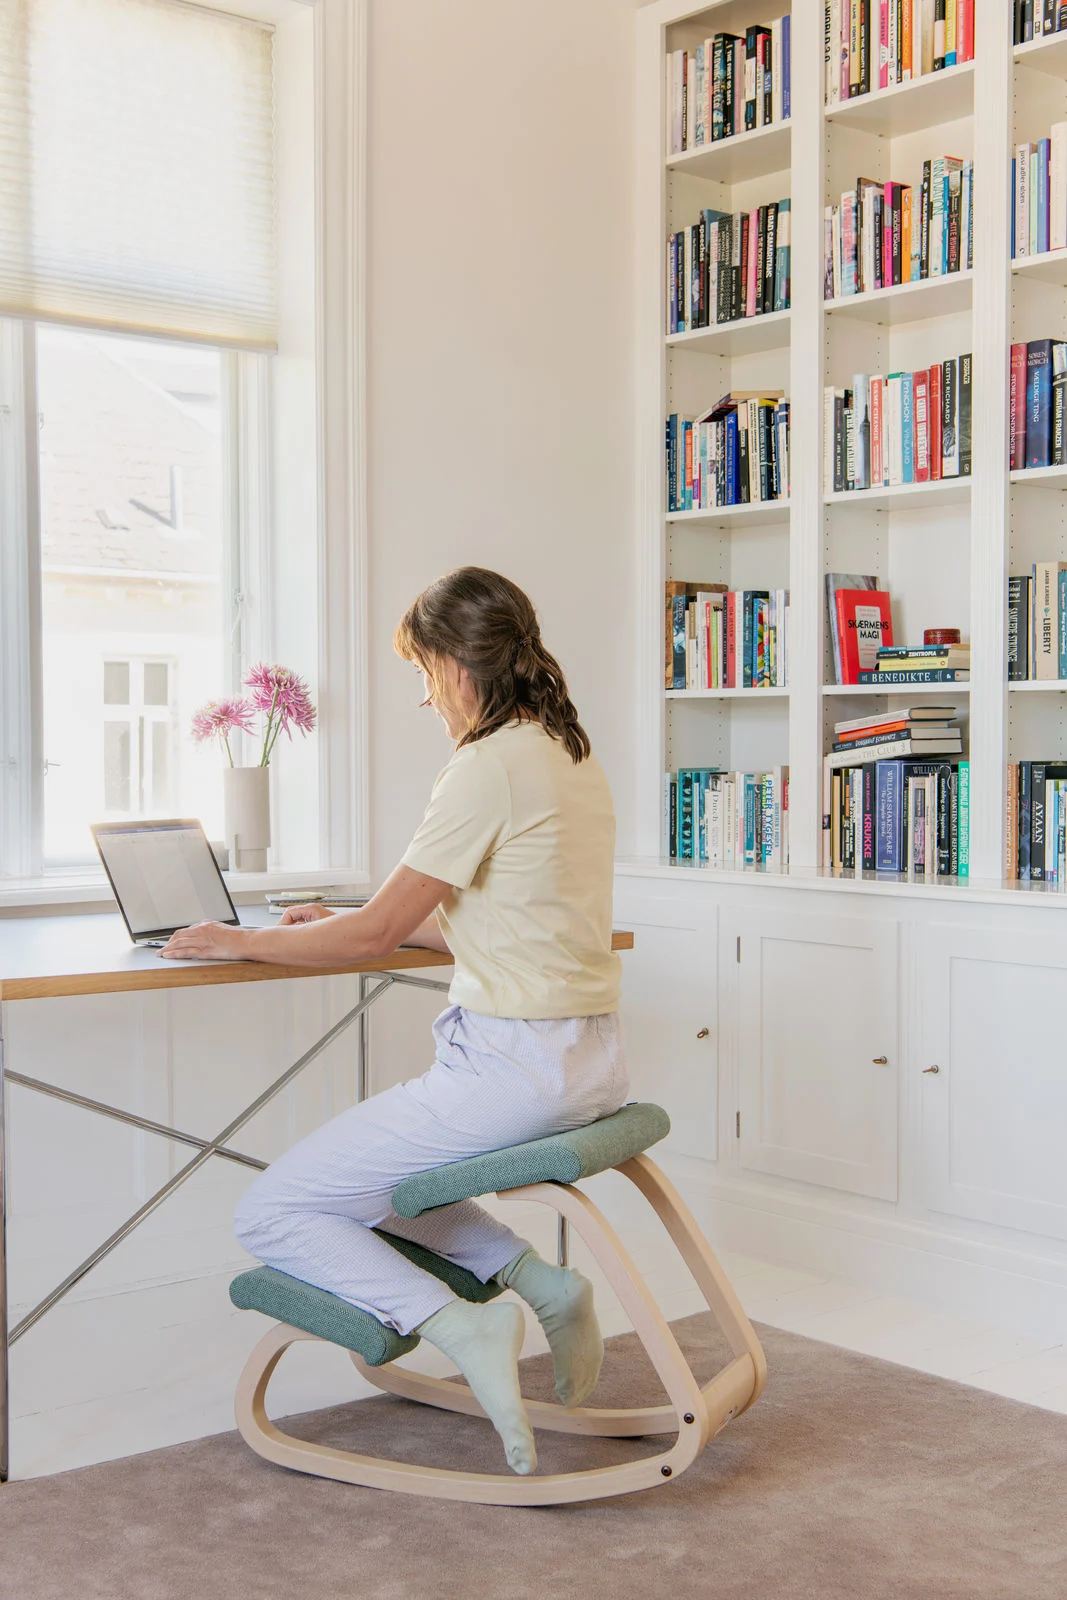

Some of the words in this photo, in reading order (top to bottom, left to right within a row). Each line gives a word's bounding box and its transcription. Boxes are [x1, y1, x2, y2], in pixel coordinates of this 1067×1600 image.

[1019, 150, 1027, 165] jussi
[932, 159, 945, 216] INNOVATION
[767, 215, 775, 231] BAD
[765, 231, 774, 278] SAMARITANS
[1027, 357, 1049, 366] MØRCH
[1028, 351, 1047, 359] SØREN
[903, 381, 911, 423] PYNCHON
[1055, 387, 1064, 419] JONATHAN
[1055, 419, 1063, 448] FRANZEN
[847, 619, 890, 630] SKÆRMENS
[859, 630, 880, 639] MAGI
[1008, 607, 1018, 635] SAMLEDE
[1008, 635, 1018, 662] STRUNGE
[1043, 617, 1051, 654] LIBERTY
[871, 672, 931, 683] BENEDIKTE
[960, 767, 969, 787] EATING
[765, 779, 773, 809] PETER
[765, 814, 773, 856] TYGESEN
[864, 813, 872, 859] KRUKKE
[1035, 801, 1044, 844] AYAAN
